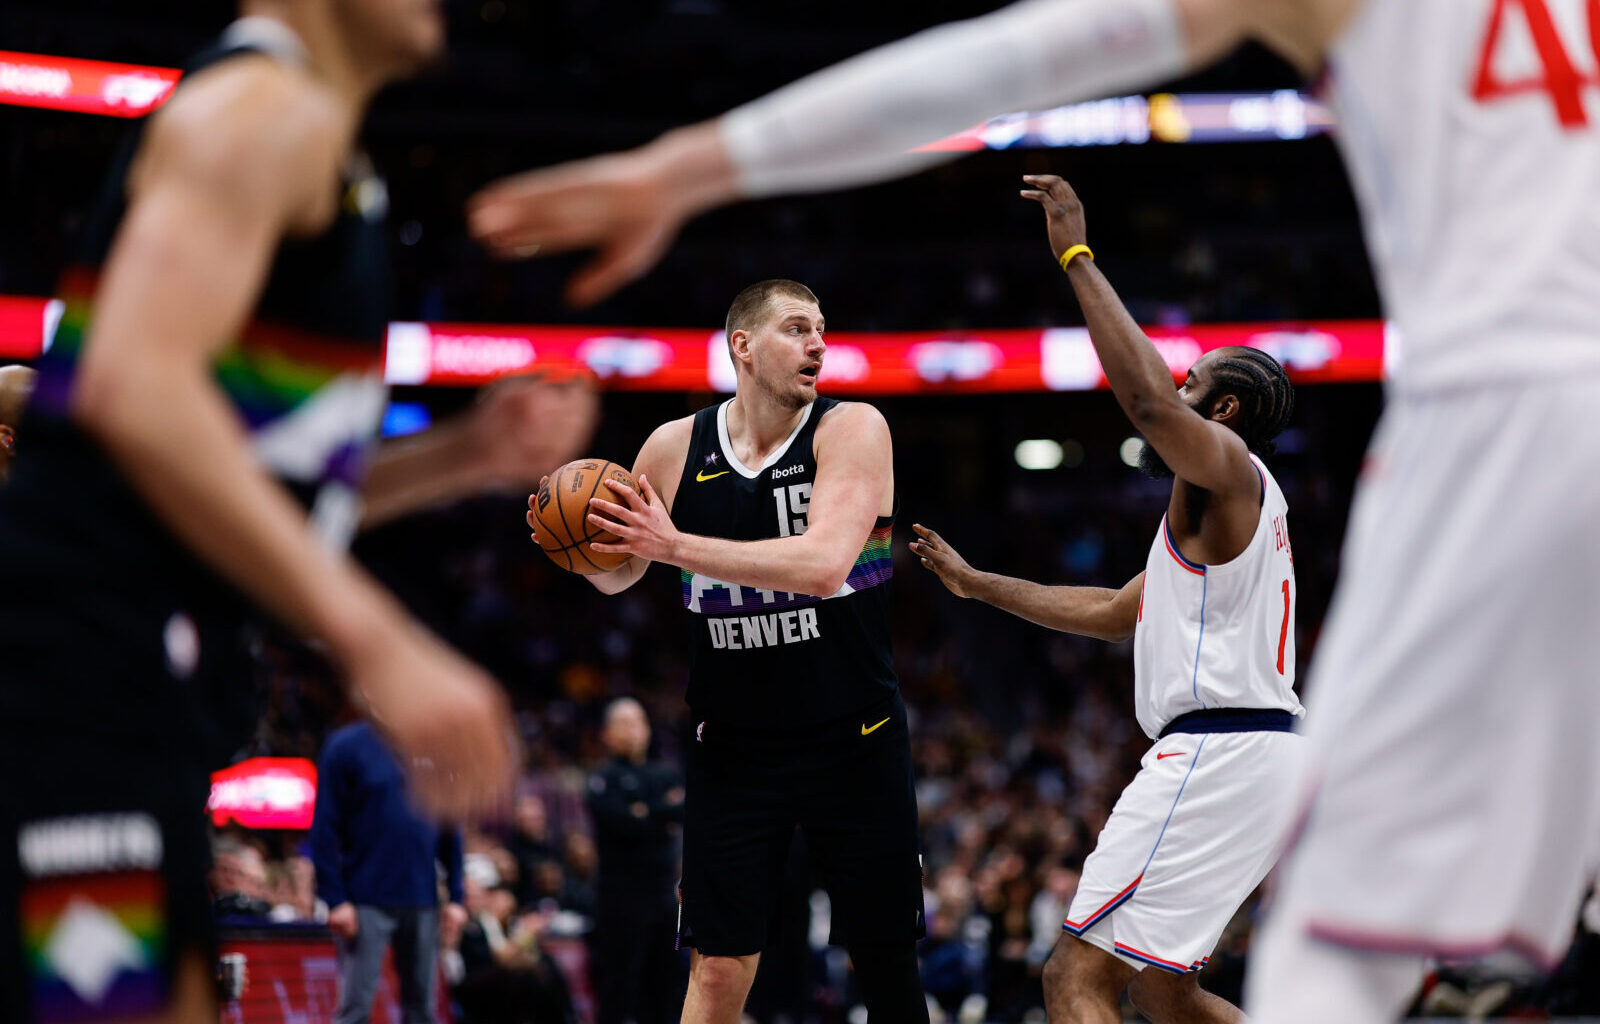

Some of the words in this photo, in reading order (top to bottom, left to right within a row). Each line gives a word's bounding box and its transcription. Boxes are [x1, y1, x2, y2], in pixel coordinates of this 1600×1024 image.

[1469, 0, 1600, 129] 4
[772, 464, 804, 479] ibotta
[773, 482, 812, 537] 15
[708, 608, 820, 649] DENVER
[1276, 579, 1289, 675] 1
